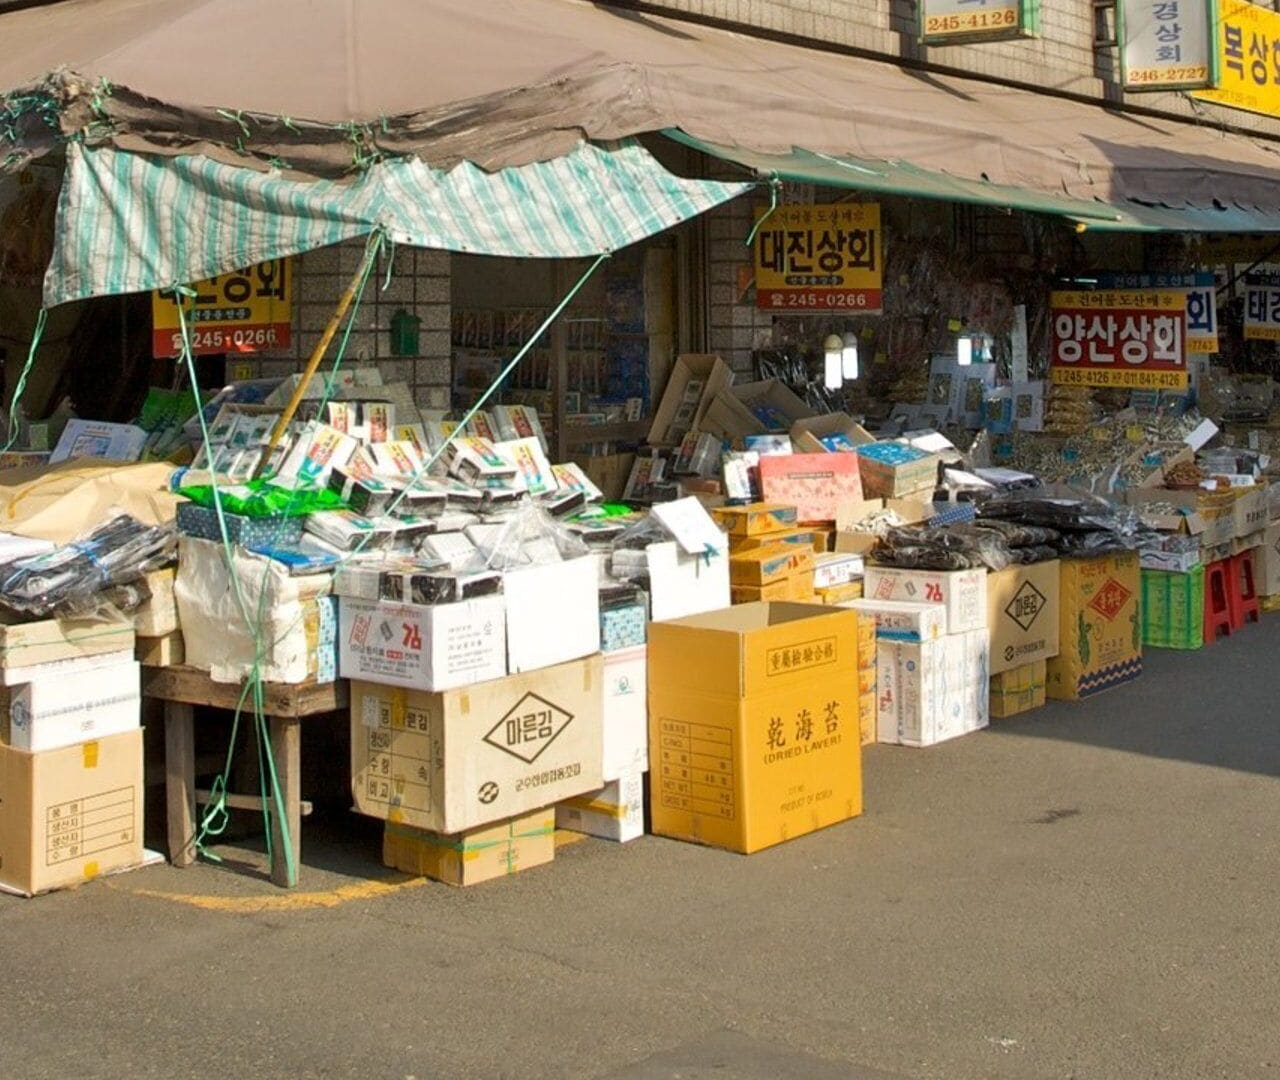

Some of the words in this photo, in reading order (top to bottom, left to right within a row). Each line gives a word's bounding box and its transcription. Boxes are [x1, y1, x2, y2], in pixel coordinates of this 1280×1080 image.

[928, 9, 1015, 32] 245-4126
[1129, 66, 1206, 83] 246-2727
[759, 228, 876, 273] 대진상회
[788, 293, 867, 307] 245-0266
[1119, 294, 1160, 308] 도산매
[192, 328, 276, 349] 245-0266
[1055, 313, 1184, 365] 양산상회
[924, 582, 943, 602] 김
[1015, 593, 1038, 618] 마른김
[401, 622, 423, 651] 김
[405, 711, 429, 732] 른김
[505, 710, 553, 747] 마른김
[766, 701, 840, 750] 乾海苔
[764, 745, 802, 766] (DRIED
[805, 735, 842, 754] LAVER)
